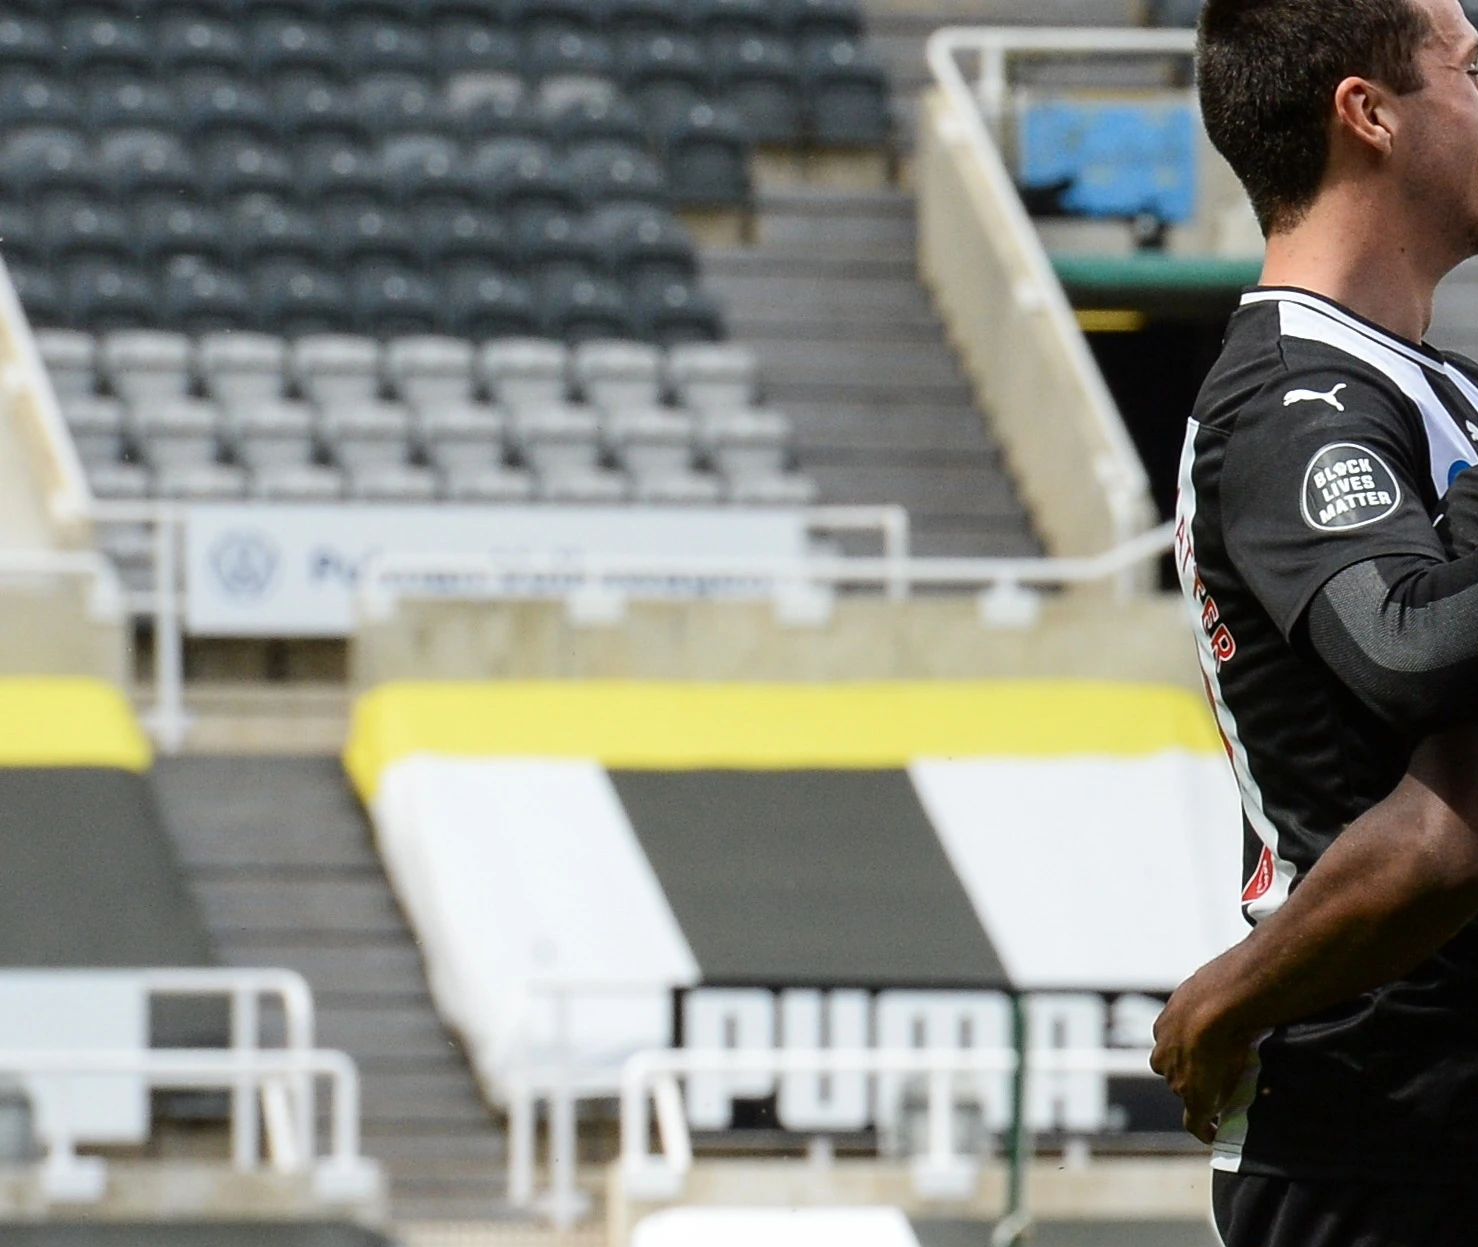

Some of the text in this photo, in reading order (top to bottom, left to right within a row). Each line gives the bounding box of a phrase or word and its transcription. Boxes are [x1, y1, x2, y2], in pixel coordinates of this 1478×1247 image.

[1321, 474, 1376, 503] LIVES
[1318, 491, 1392, 524] MATTER
[1173, 515, 1237, 675] ATTER
